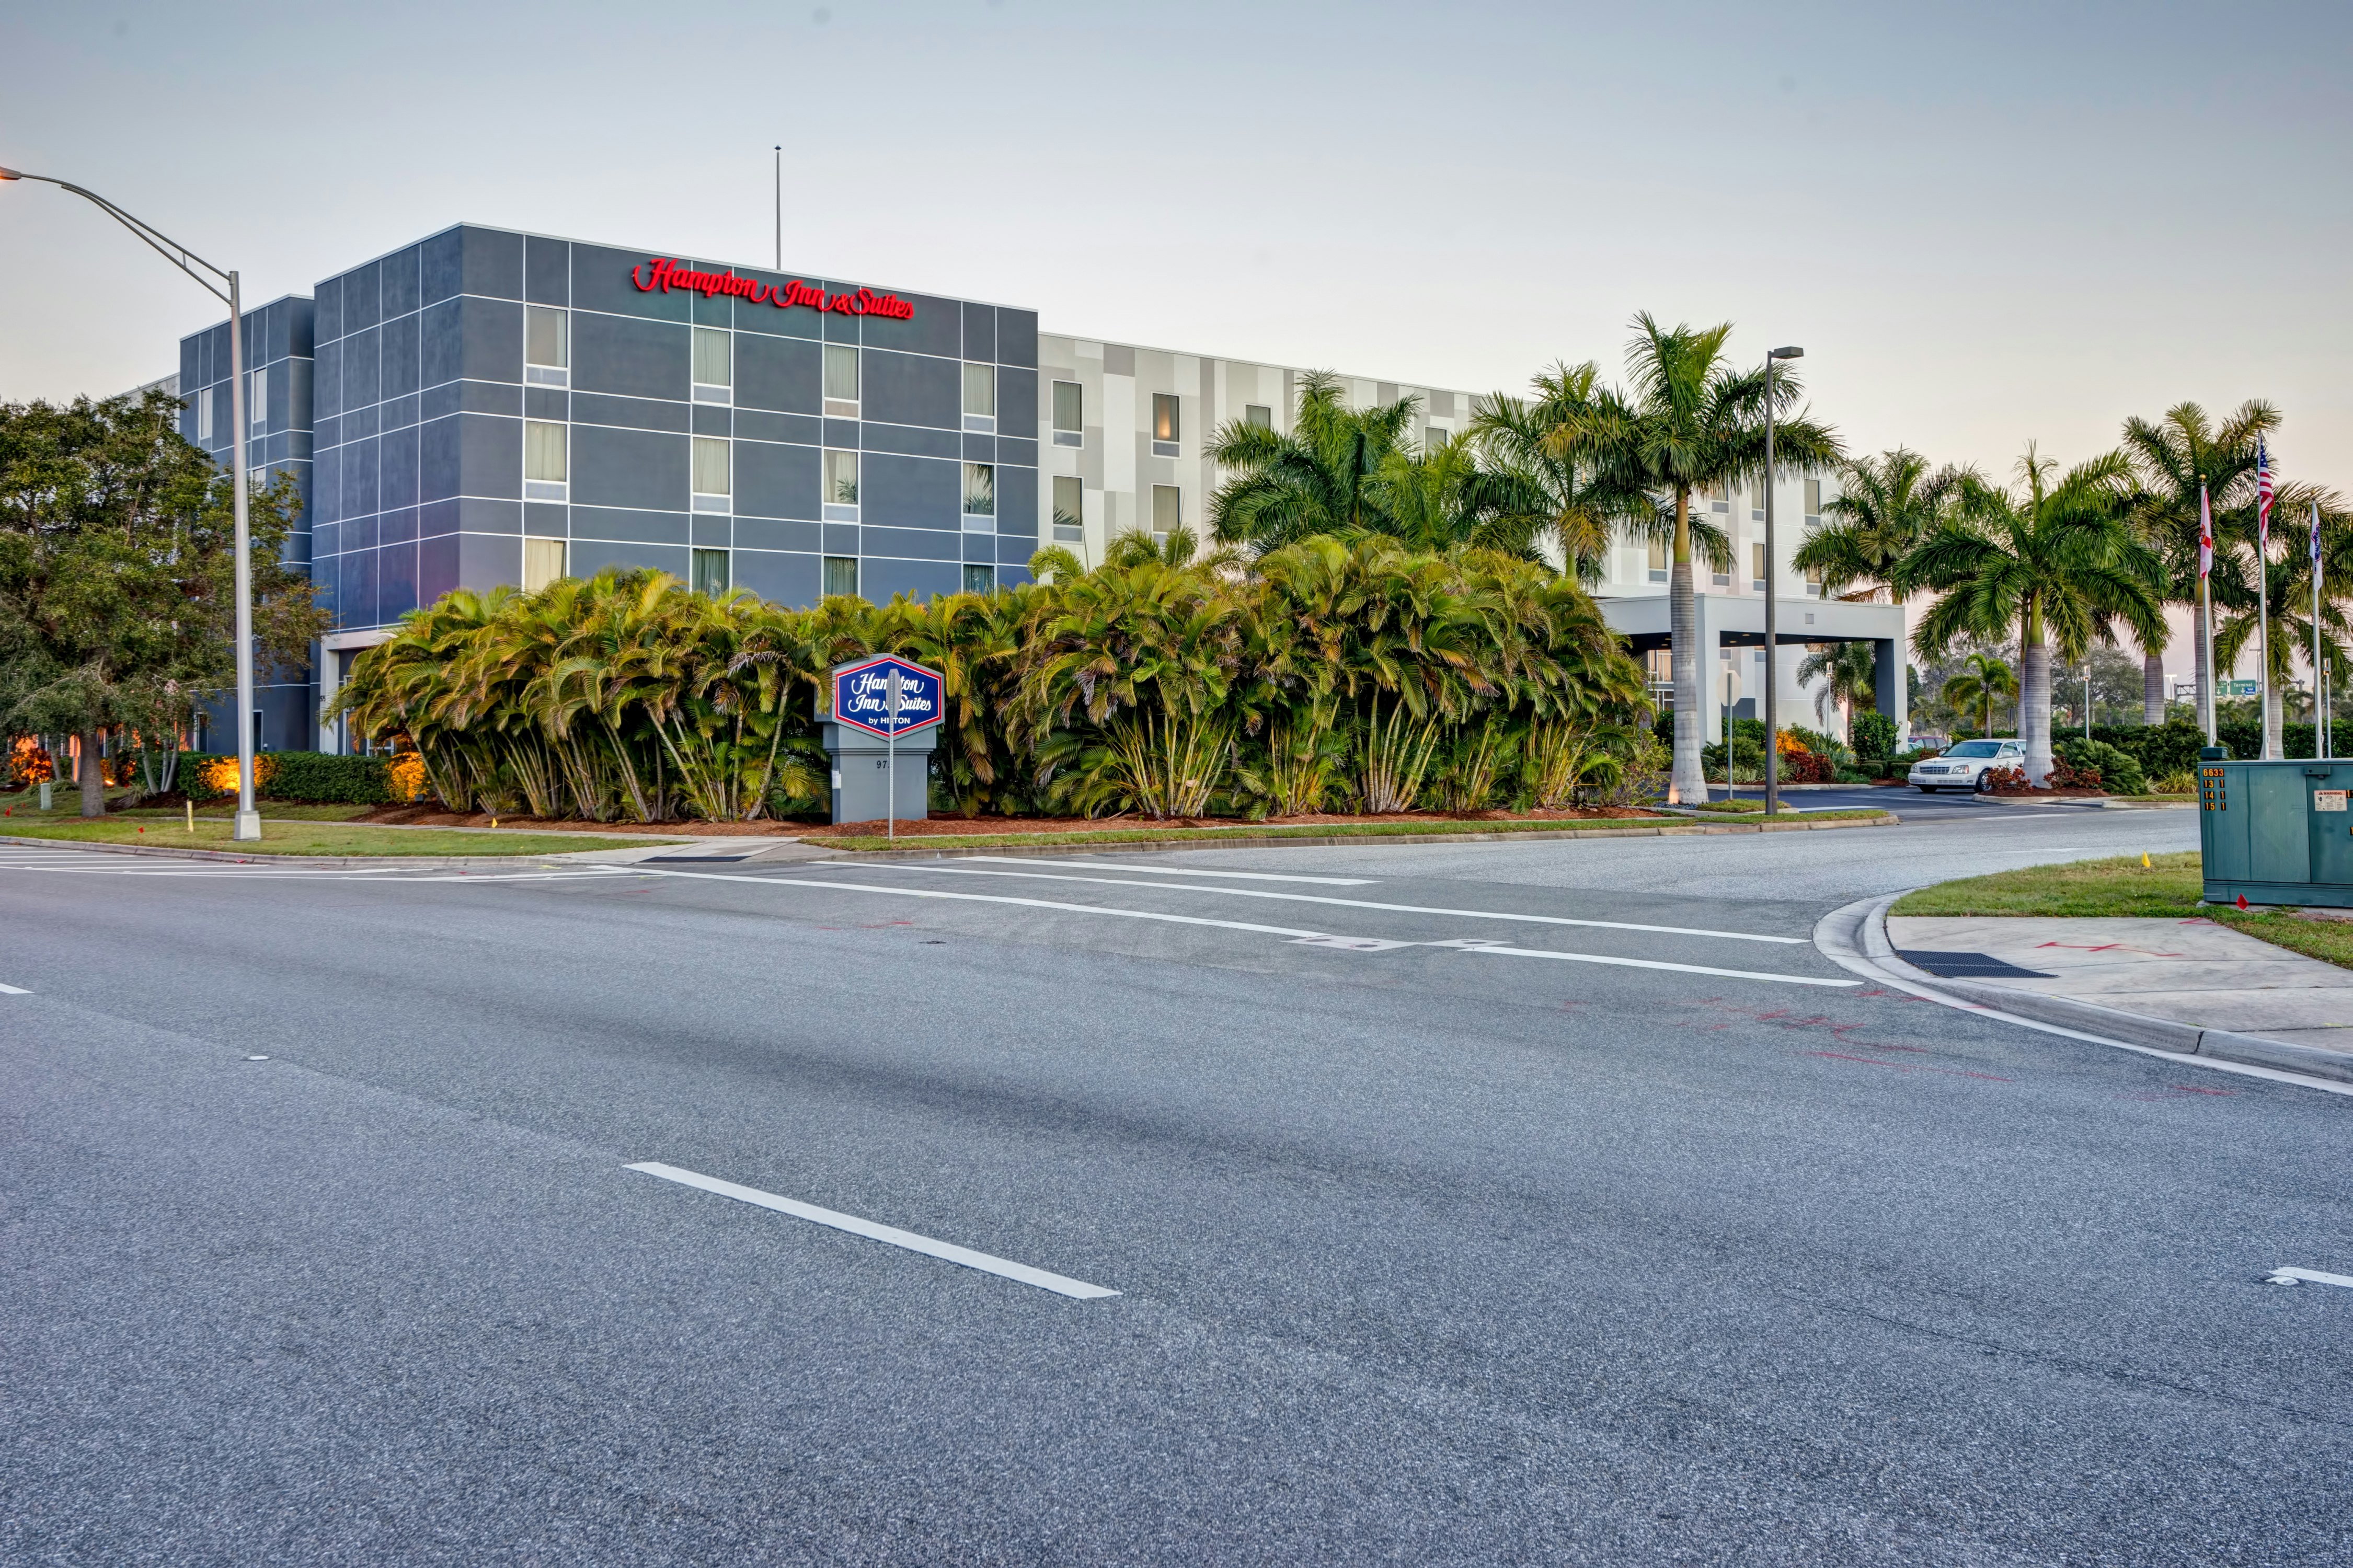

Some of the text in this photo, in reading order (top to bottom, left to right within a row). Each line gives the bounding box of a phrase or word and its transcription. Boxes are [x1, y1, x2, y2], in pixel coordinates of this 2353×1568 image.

[633, 258, 914, 319] Hampton Inn & Suites
[851, 673, 924, 695] Hamton
[848, 694, 886, 712] Inn
[876, 760, 890, 768] 97
[2203, 768, 2224, 777] 6633
[2204, 779, 2224, 788] 13 1
[2205, 791, 2224, 799] 14 1
